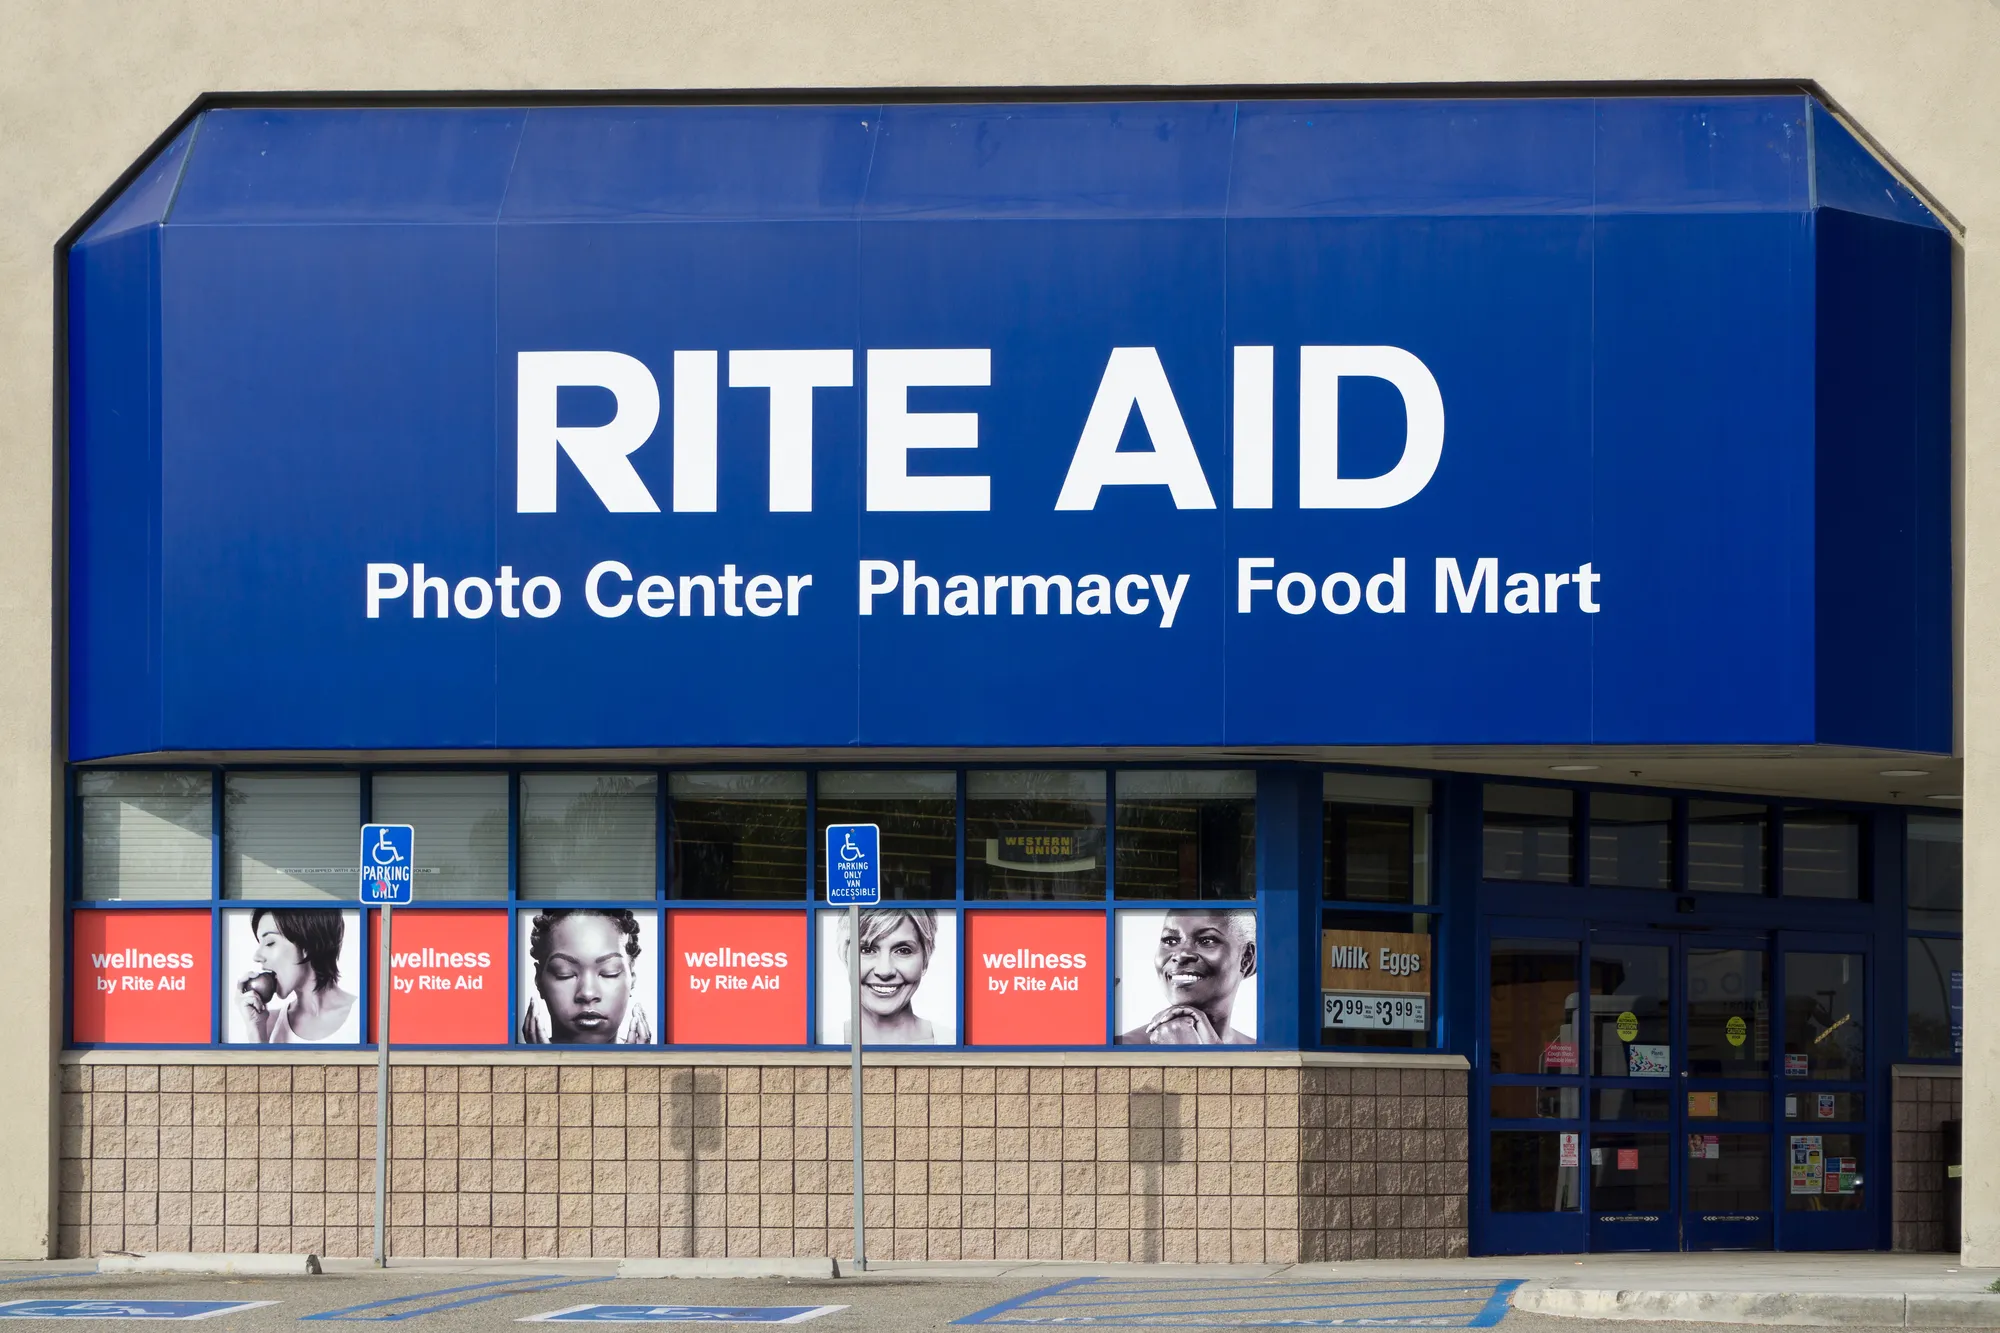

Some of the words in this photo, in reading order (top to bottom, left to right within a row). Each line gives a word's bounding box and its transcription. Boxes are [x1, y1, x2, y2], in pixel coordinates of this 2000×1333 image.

[516, 348, 992, 514] RITE
[1054, 345, 1445, 511] AID
[366, 563, 562, 619] Photo
[585, 560, 813, 618] Center
[859, 559, 1191, 628] Pharmacy
[1238, 557, 1406, 615] Food
[1435, 557, 1601, 614] Mart
[1004, 836, 1070, 846] WESTERN
[1025, 845, 1070, 855] UNION
[363, 865, 410, 881] PARKING
[837, 861, 869, 870] PARKING
[843, 871, 862, 879] ONLY
[831, 888, 876, 897] ACCESSIBLE
[846, 879, 861, 888] VAN
[91, 948, 194, 969] wellness
[391, 947, 491, 968] wellness
[684, 948, 788, 969] wellness
[982, 948, 1087, 969] wellness
[1331, 945, 1369, 969] Milk
[1379, 947, 1420, 976] Eggs
[97, 976, 117, 994] by
[122, 976, 154, 991] Rite
[157, 976, 186, 991] Aid
[393, 975, 414, 994] by
[419, 975, 451, 990] Rite
[454, 975, 483, 990] Aid
[689, 975, 711, 994] by
[716, 975, 748, 990] Rite
[751, 975, 780, 990] Aid
[988, 976, 1010, 995] by
[1014, 976, 1047, 991] Rite
[1049, 976, 1079, 991] Aid
